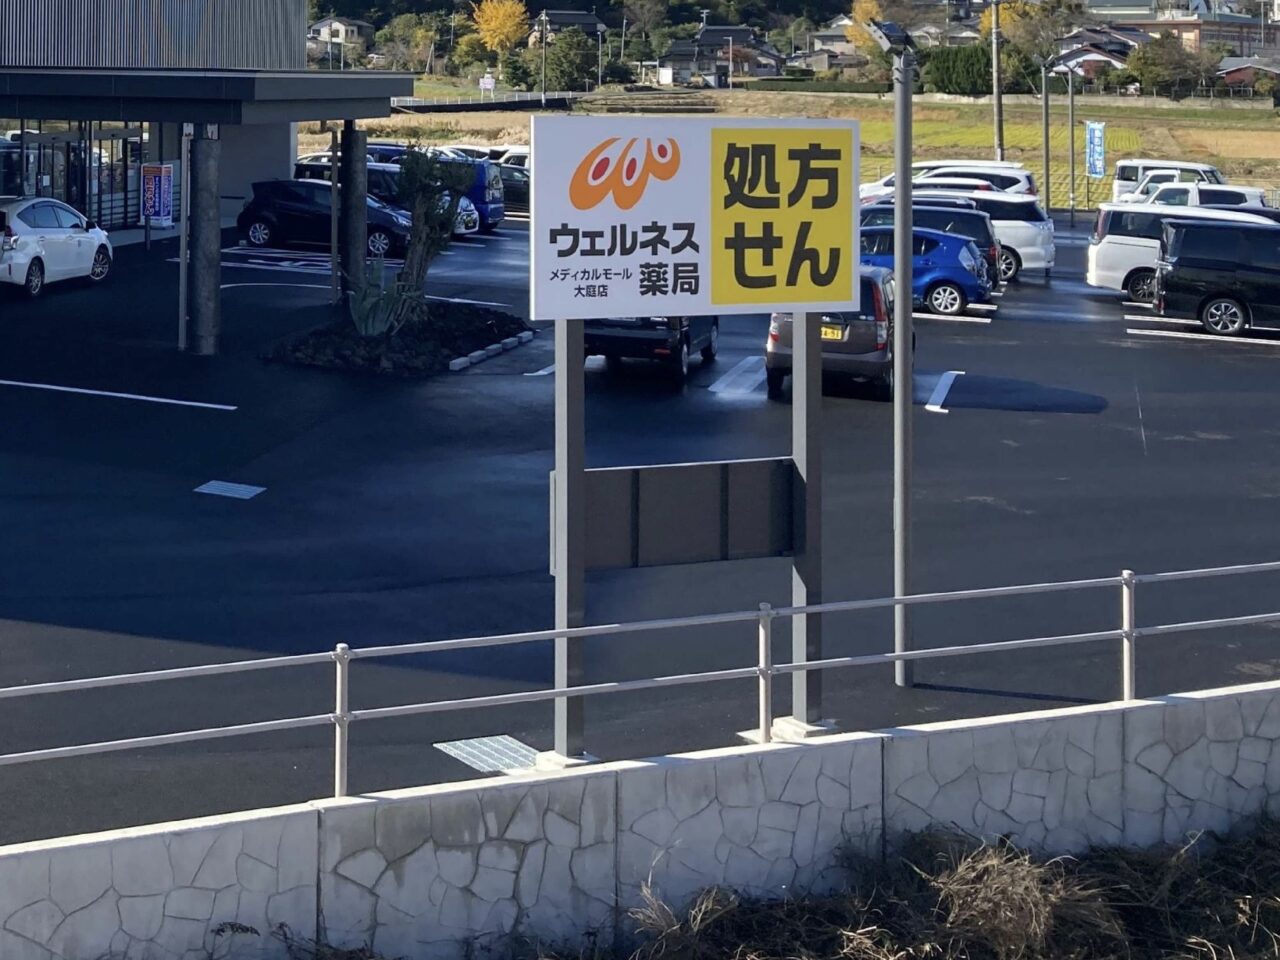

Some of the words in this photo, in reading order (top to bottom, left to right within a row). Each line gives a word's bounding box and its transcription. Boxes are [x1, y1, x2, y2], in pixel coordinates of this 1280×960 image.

[723, 142, 842, 210] 処方
[549, 222, 700, 258] ウェルネス
[724, 221, 841, 289] せん
[549, 267, 632, 282] メディカルモール
[573, 284, 608, 298] 大庭店
[638, 262, 700, 296] 薬局
